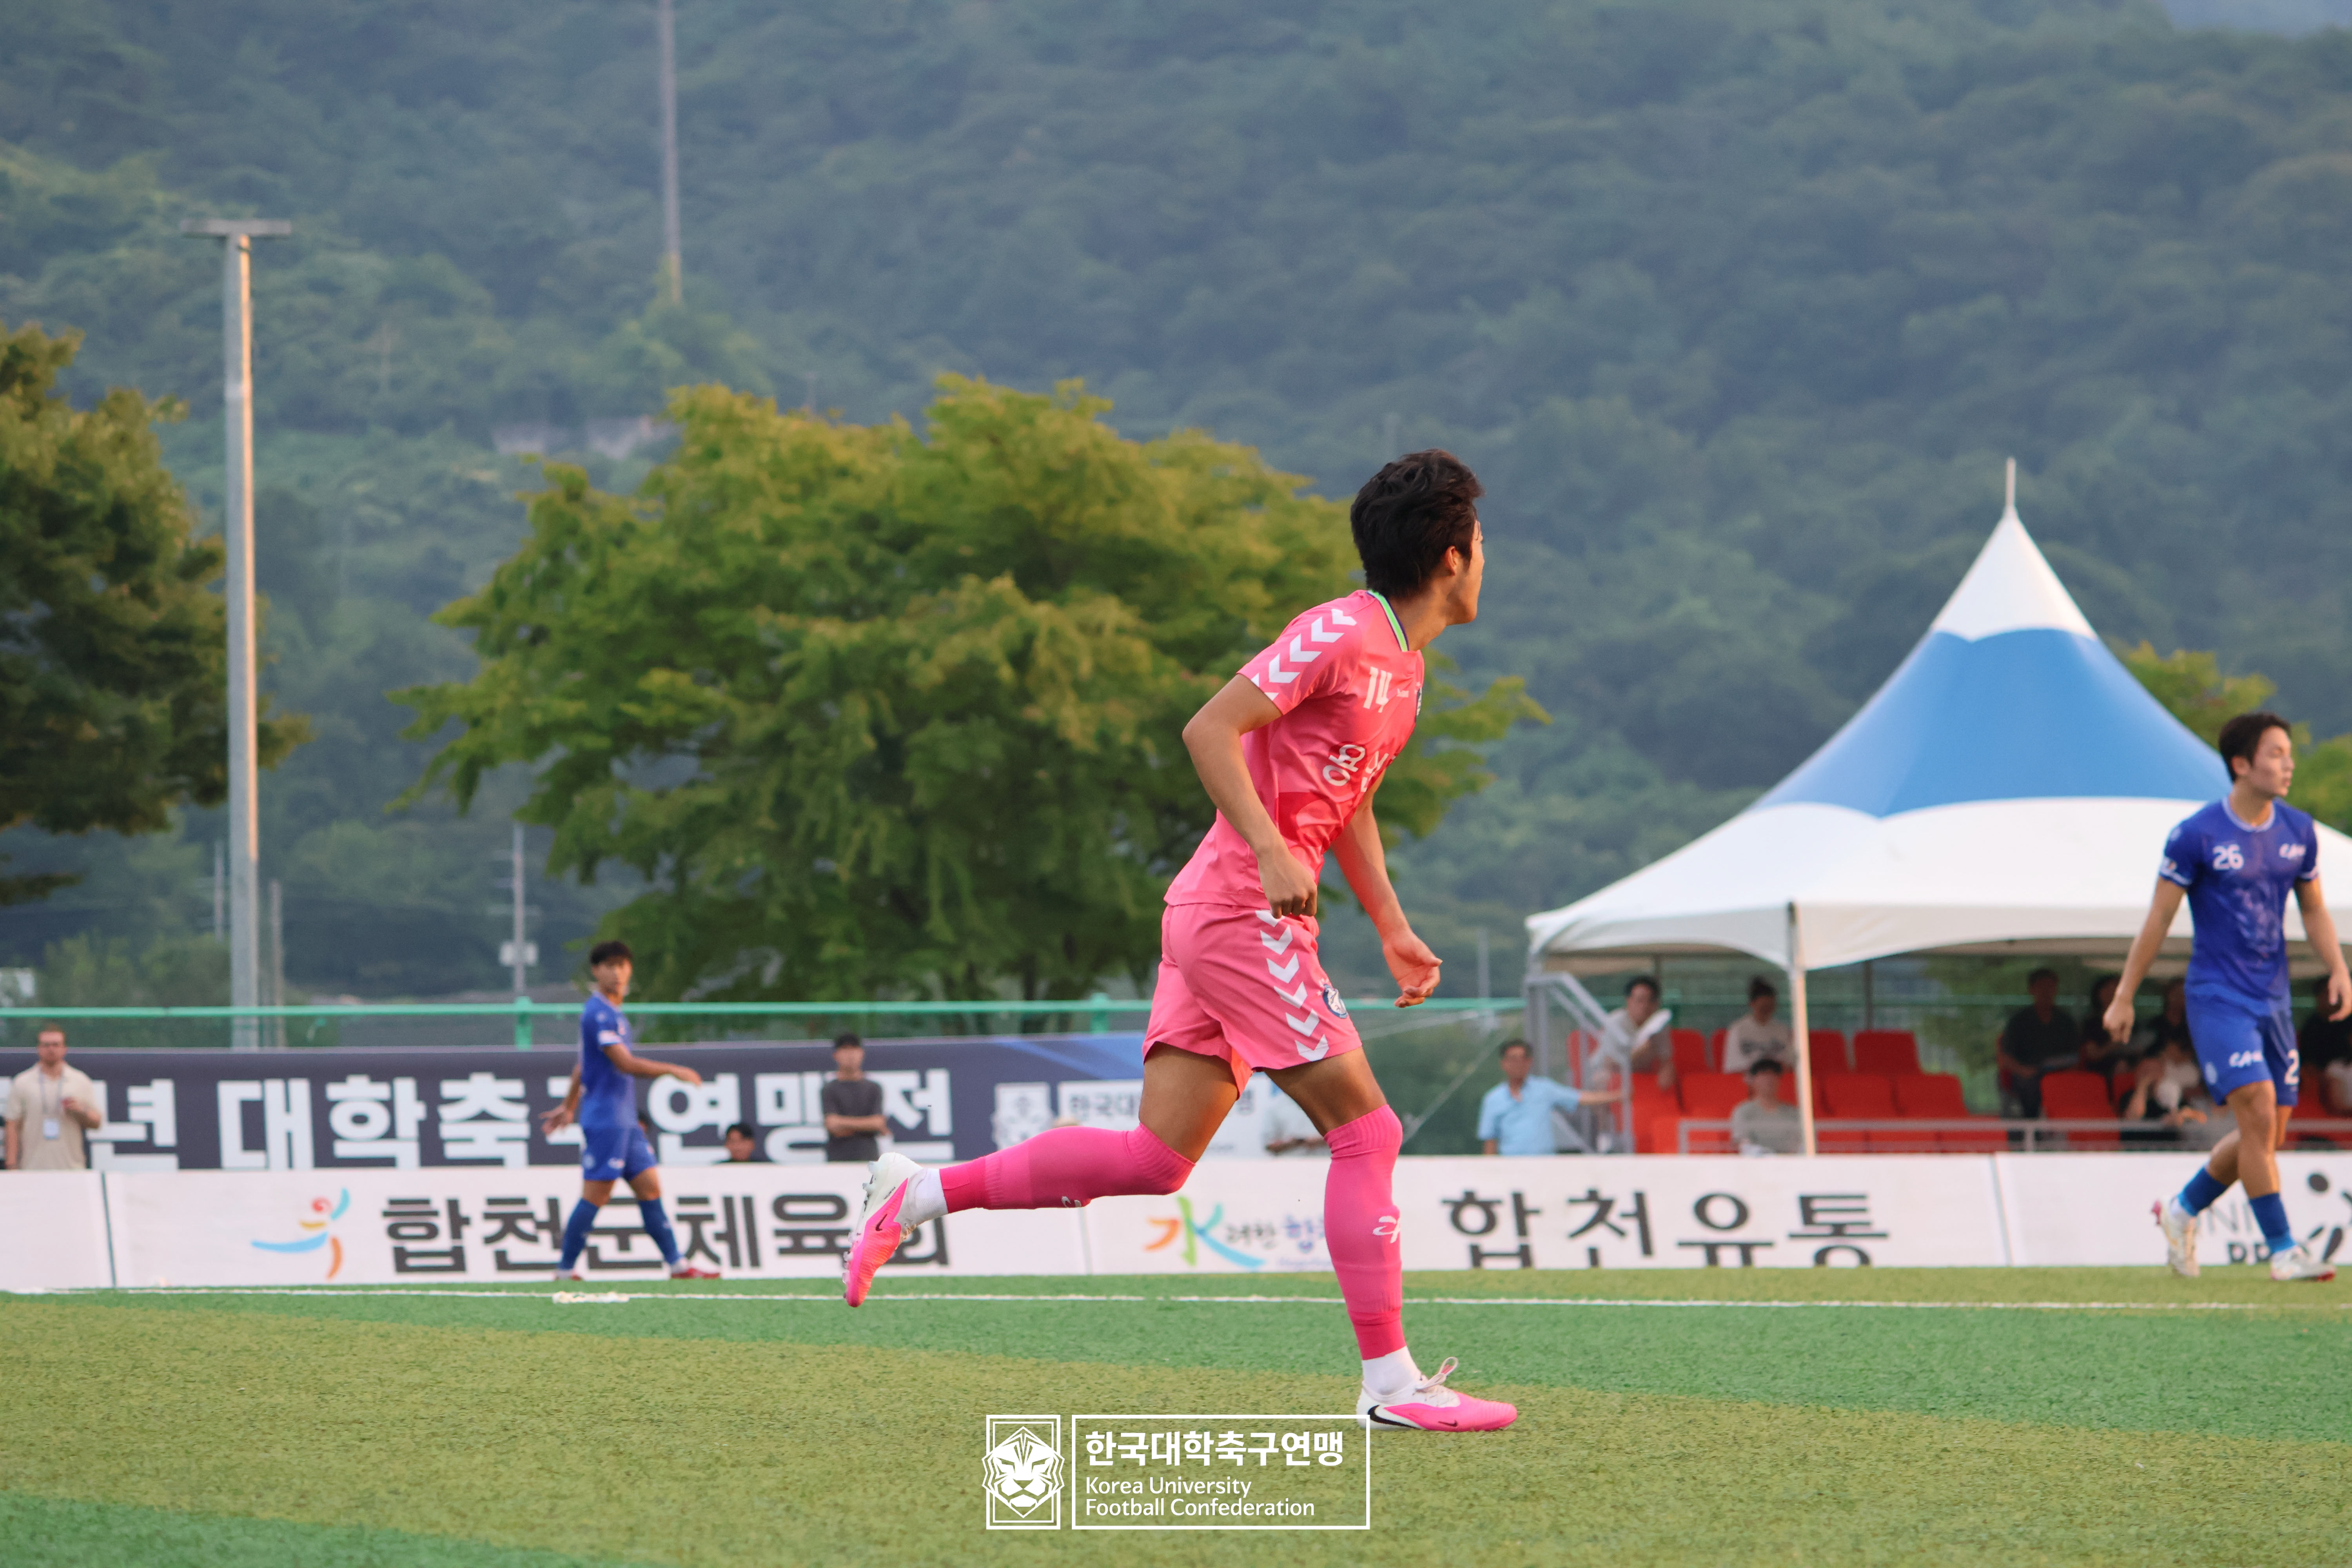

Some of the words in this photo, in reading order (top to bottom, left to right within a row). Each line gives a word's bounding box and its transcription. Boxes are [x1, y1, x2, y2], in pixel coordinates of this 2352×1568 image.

[1363, 666, 1392, 713] 14
[2212, 844, 2244, 870] 26
[1441, 1189, 1889, 1269] 합천유통
